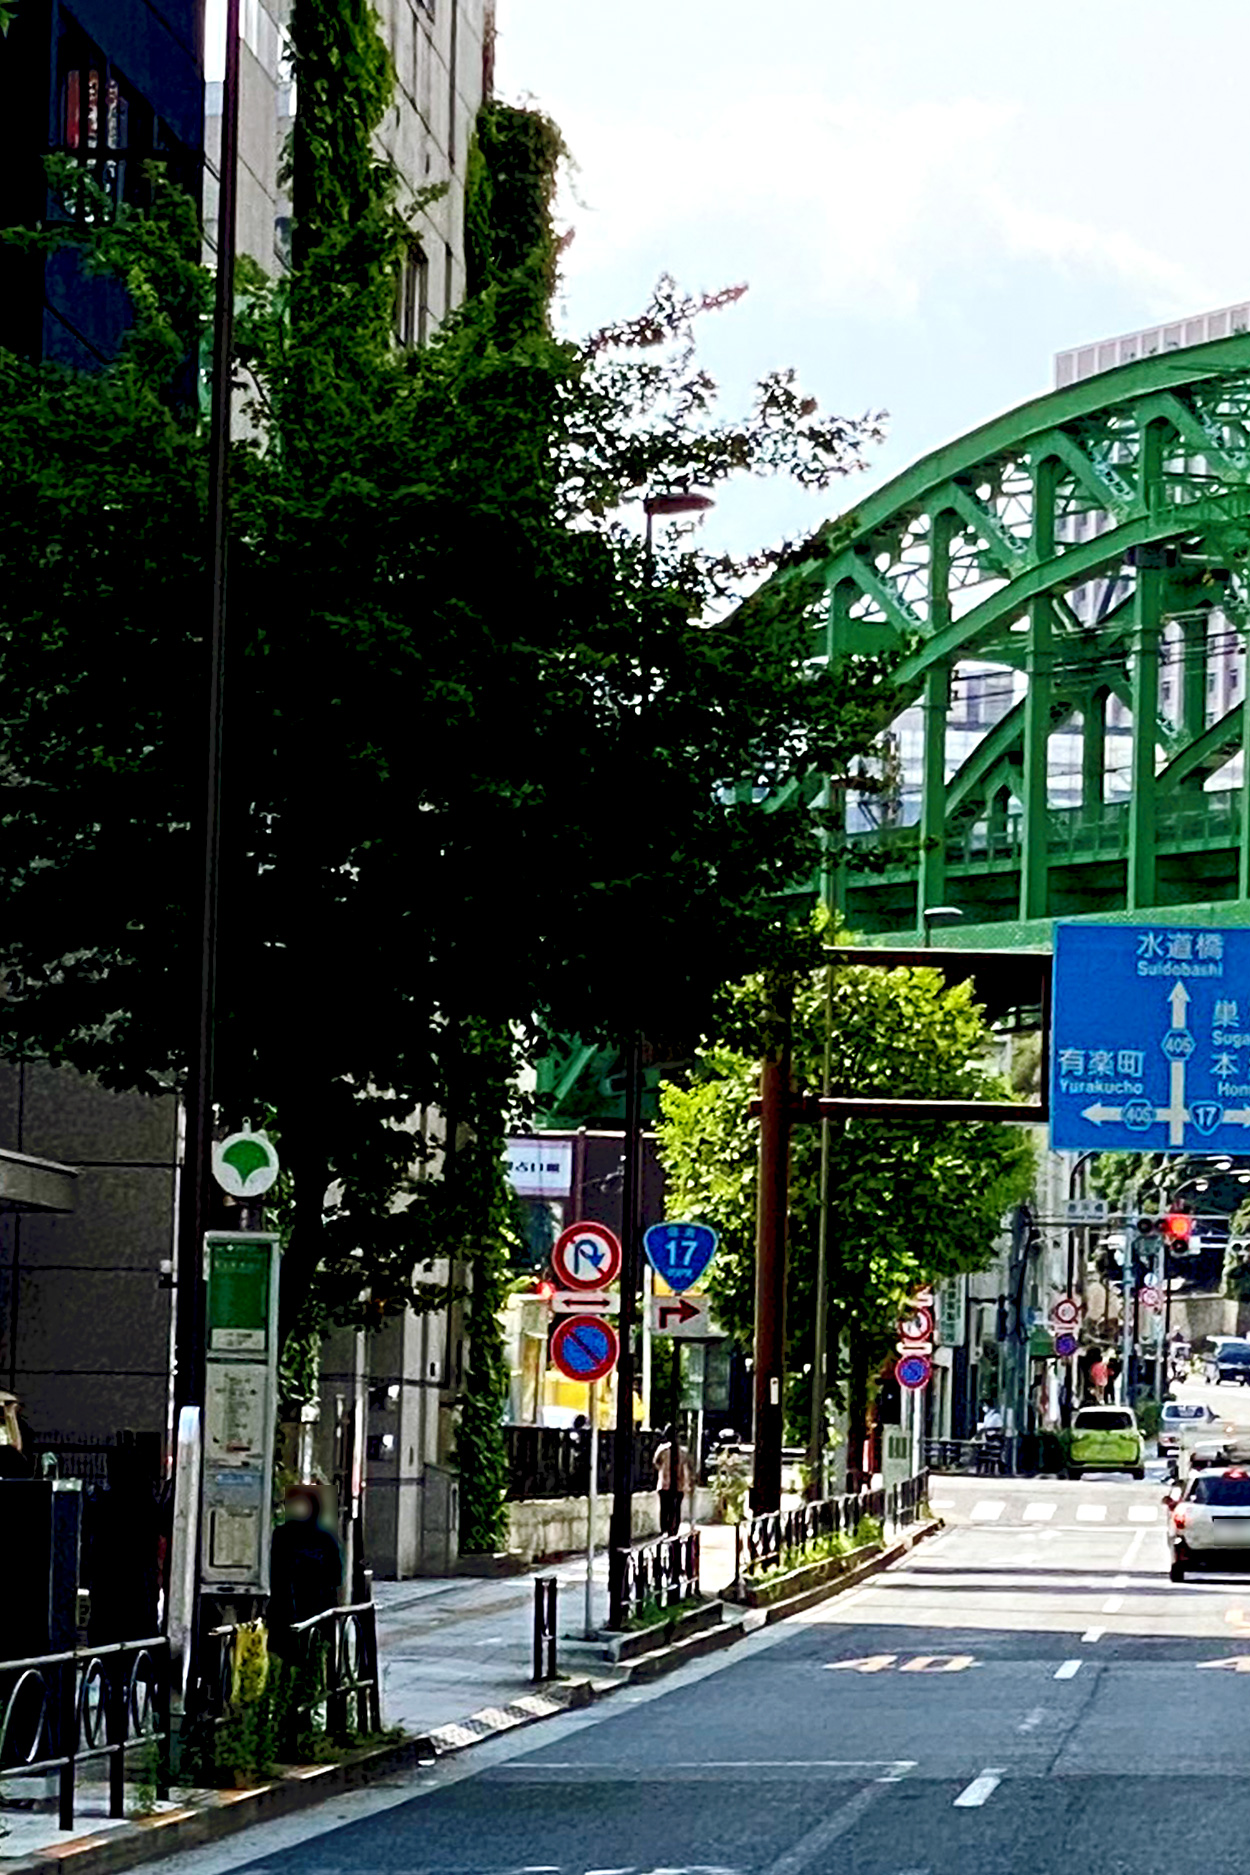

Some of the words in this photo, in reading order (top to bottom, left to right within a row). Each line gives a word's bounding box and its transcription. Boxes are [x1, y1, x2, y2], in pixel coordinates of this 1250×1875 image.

[1136, 931, 1224, 960] 水道橋
[1137, 961, 1223, 977] Suidobashi
[1058, 1048, 1146, 1077] 有楽町
[1060, 1079, 1144, 1095] Yurakucho
[1196, 1107, 1217, 1127] 17
[665, 1240, 698, 1266] 17
